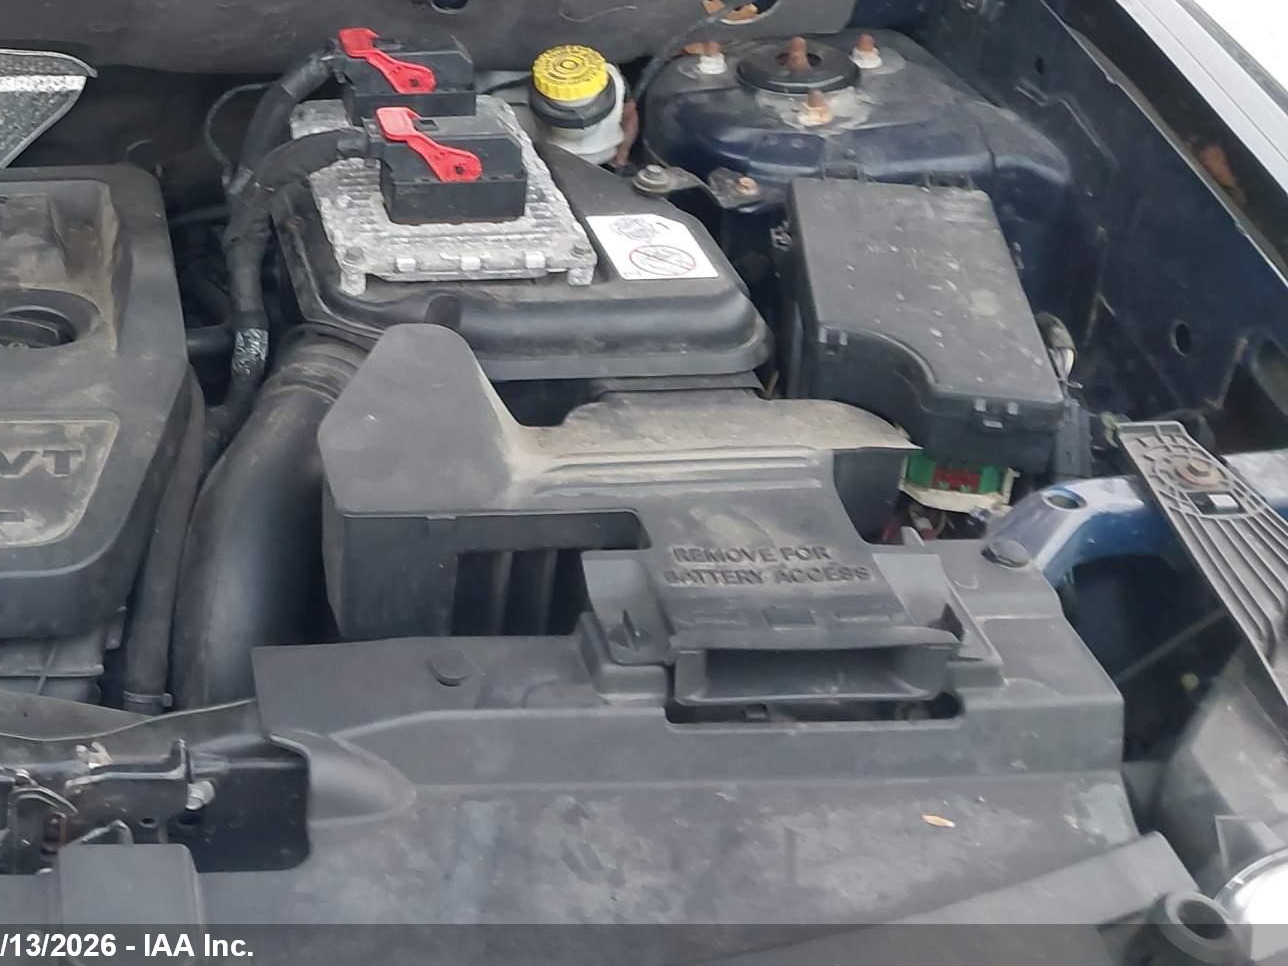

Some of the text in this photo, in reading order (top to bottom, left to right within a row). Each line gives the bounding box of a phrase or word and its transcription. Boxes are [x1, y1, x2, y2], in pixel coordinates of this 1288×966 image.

[671, 545, 832, 563] REMOVE FOR
[663, 566, 872, 585] BATTERY ACCESS
